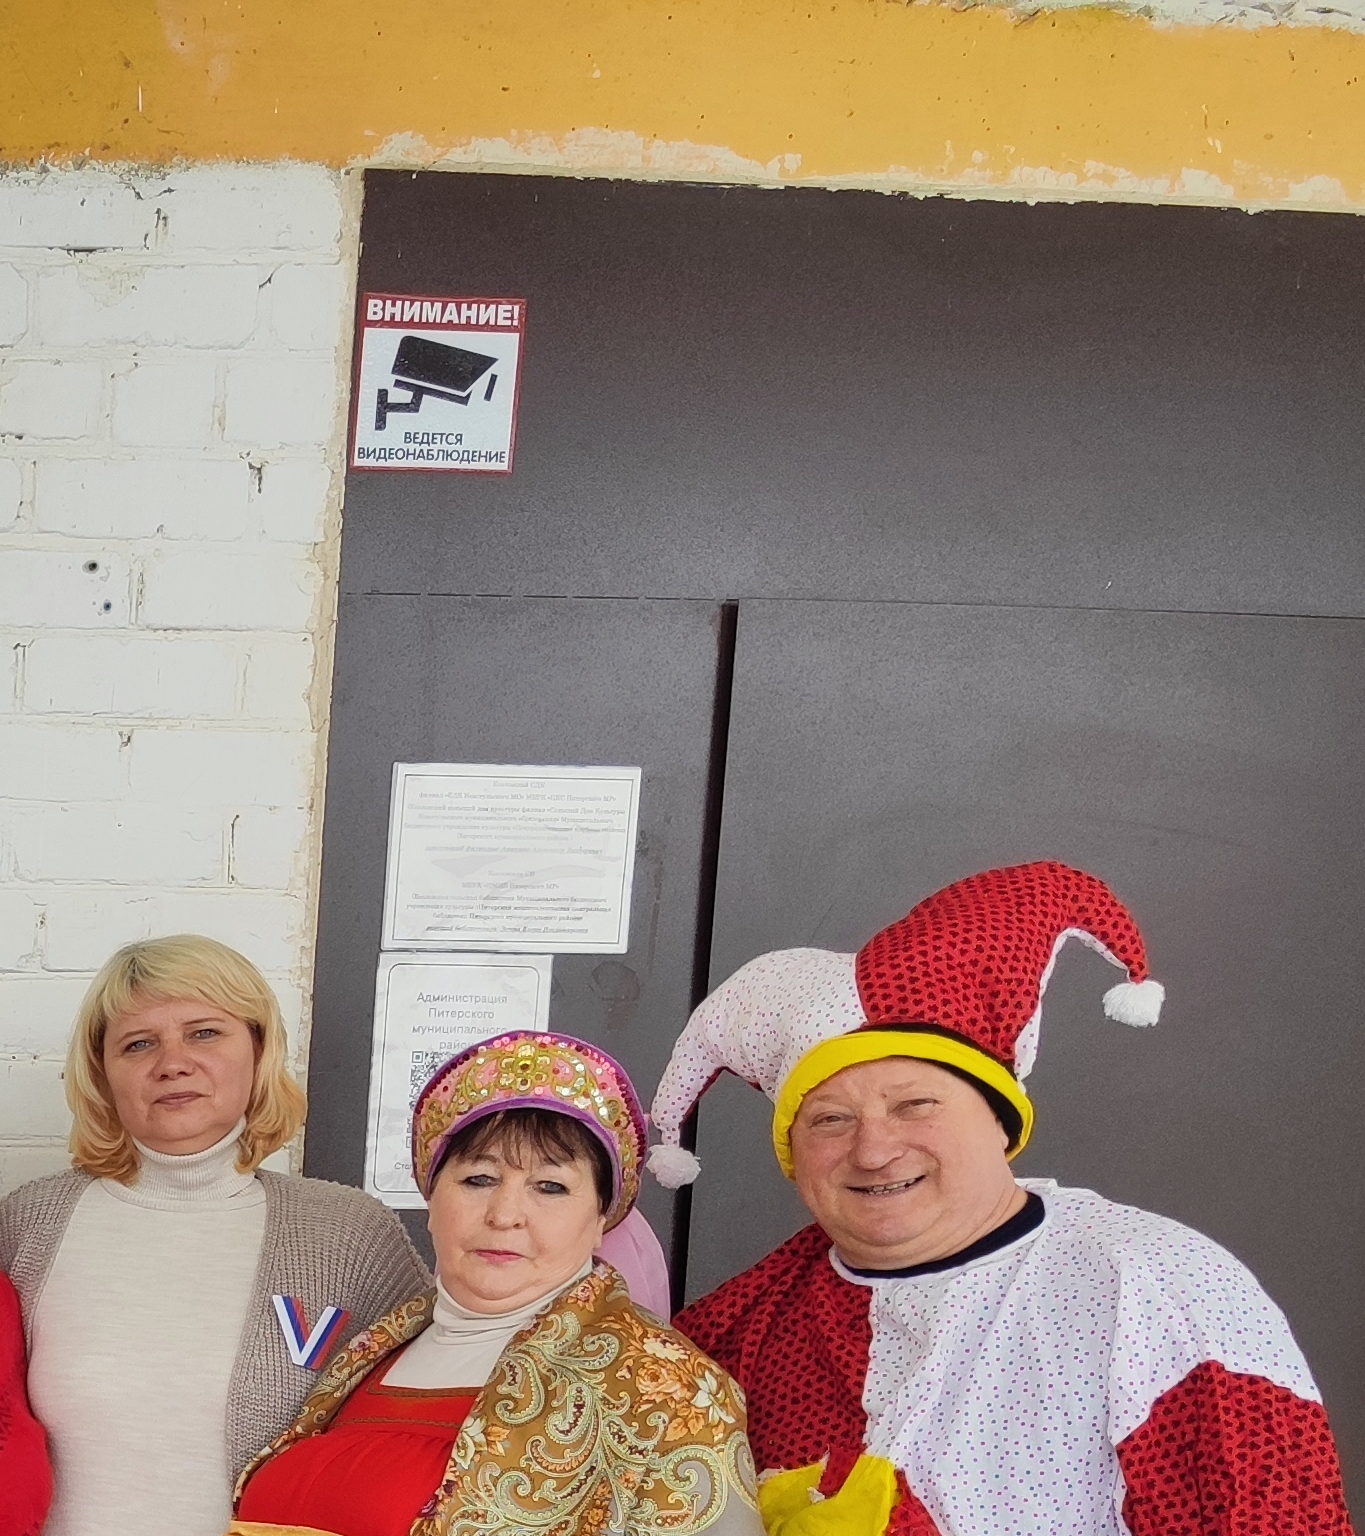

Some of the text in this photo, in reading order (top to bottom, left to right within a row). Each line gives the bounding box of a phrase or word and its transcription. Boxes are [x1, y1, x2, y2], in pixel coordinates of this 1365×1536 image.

[366, 299, 520, 326] ВНИМАНИЕ!
[403, 431, 463, 447] ВЕДЕТСЯ
[357, 447, 506, 464] ВИДЕОНАБЛЮДЕНИЕ
[416, 991, 508, 1005] Администрация
[428, 1007, 495, 1020] Питерского
